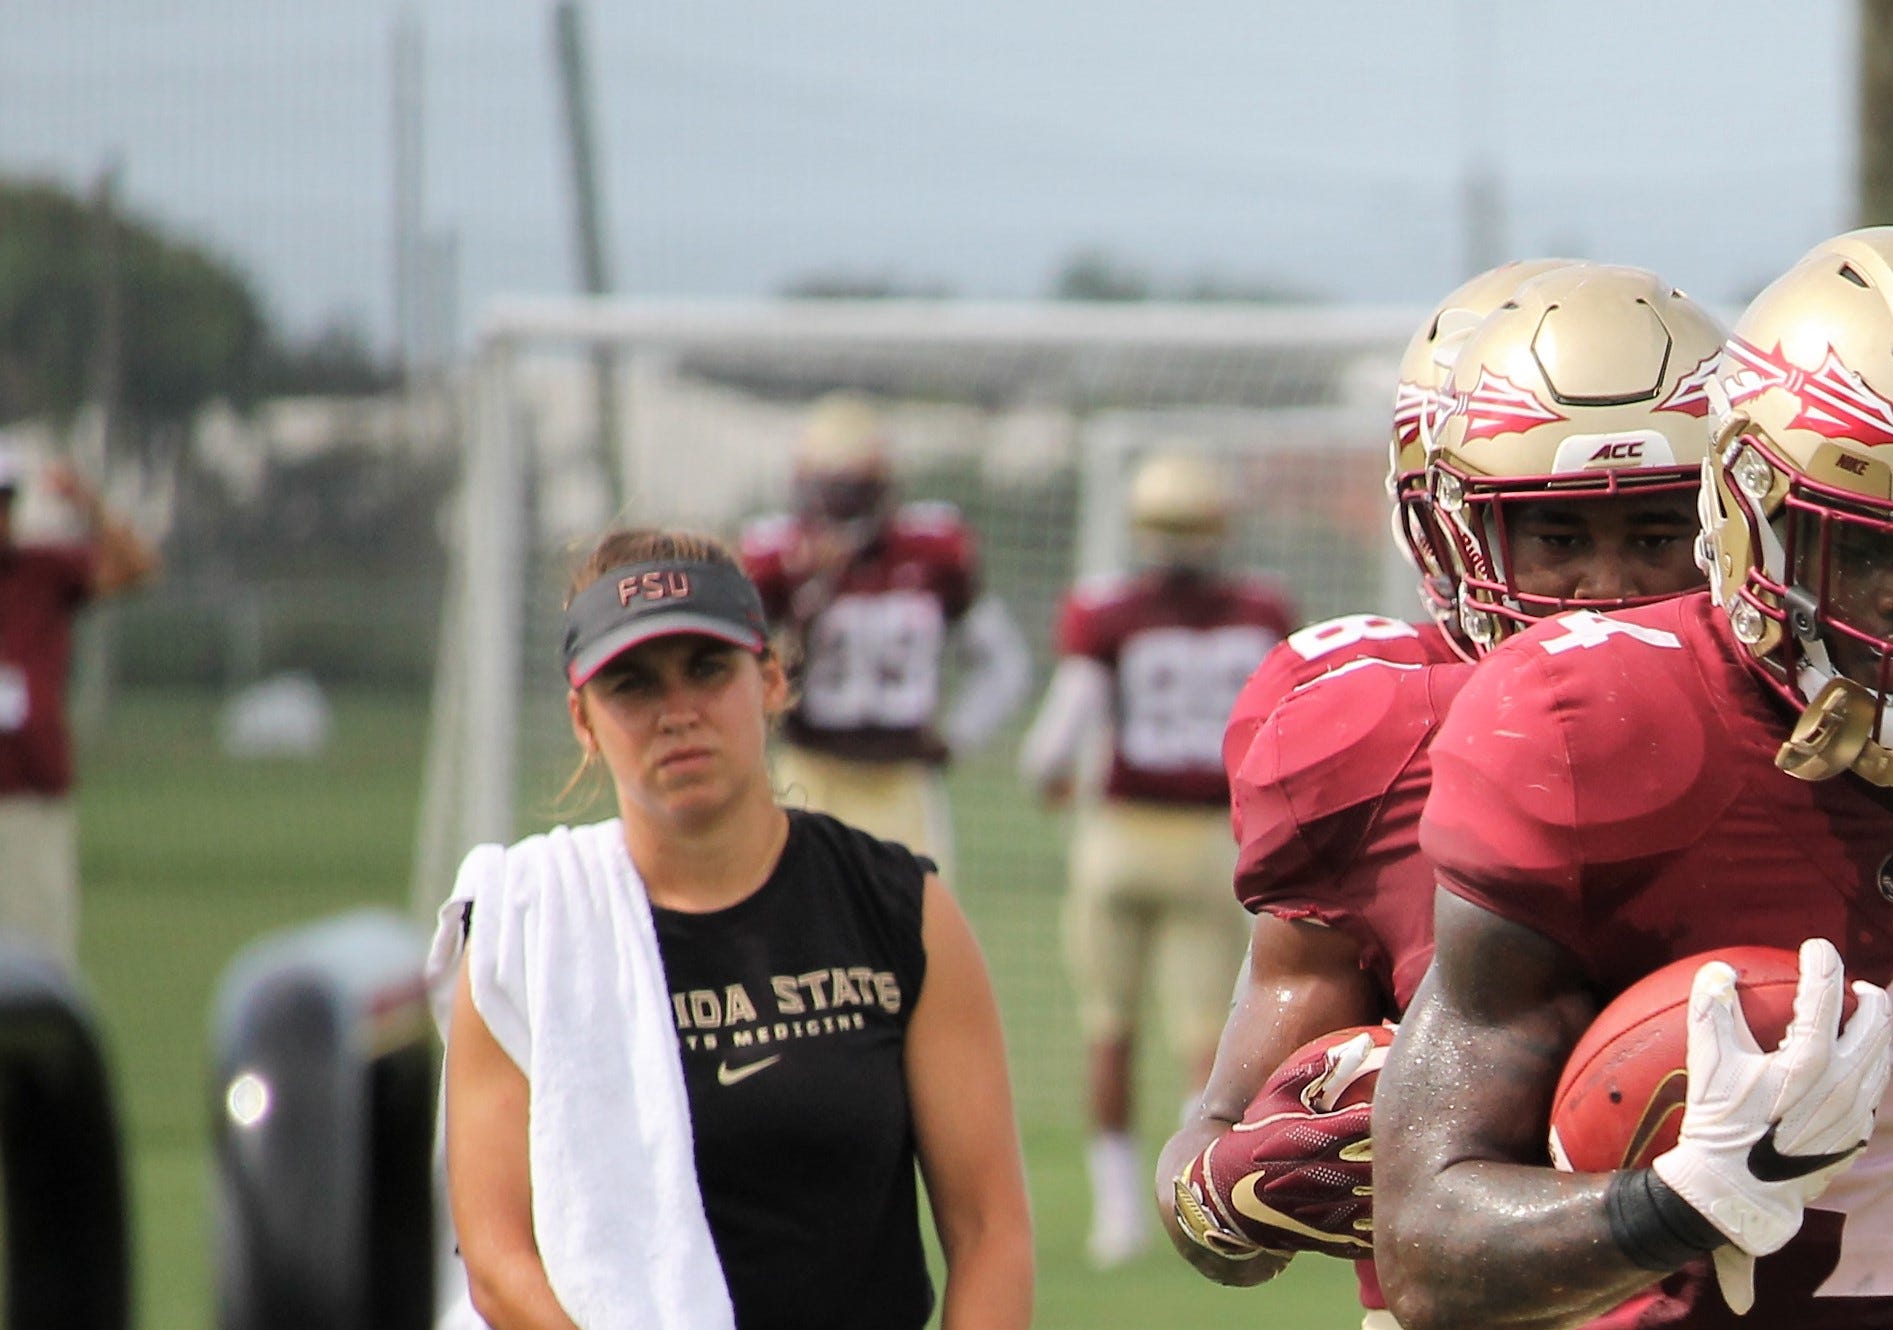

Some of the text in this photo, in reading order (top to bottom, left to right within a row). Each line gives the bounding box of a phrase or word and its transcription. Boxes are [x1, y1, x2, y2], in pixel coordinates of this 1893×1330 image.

[1588, 441, 1646, 461] ACC
[1835, 453, 1869, 476] NIKE
[618, 571, 690, 607] FSU
[1539, 609, 1682, 655] 4
[672, 966, 901, 1028] IDA STATE
